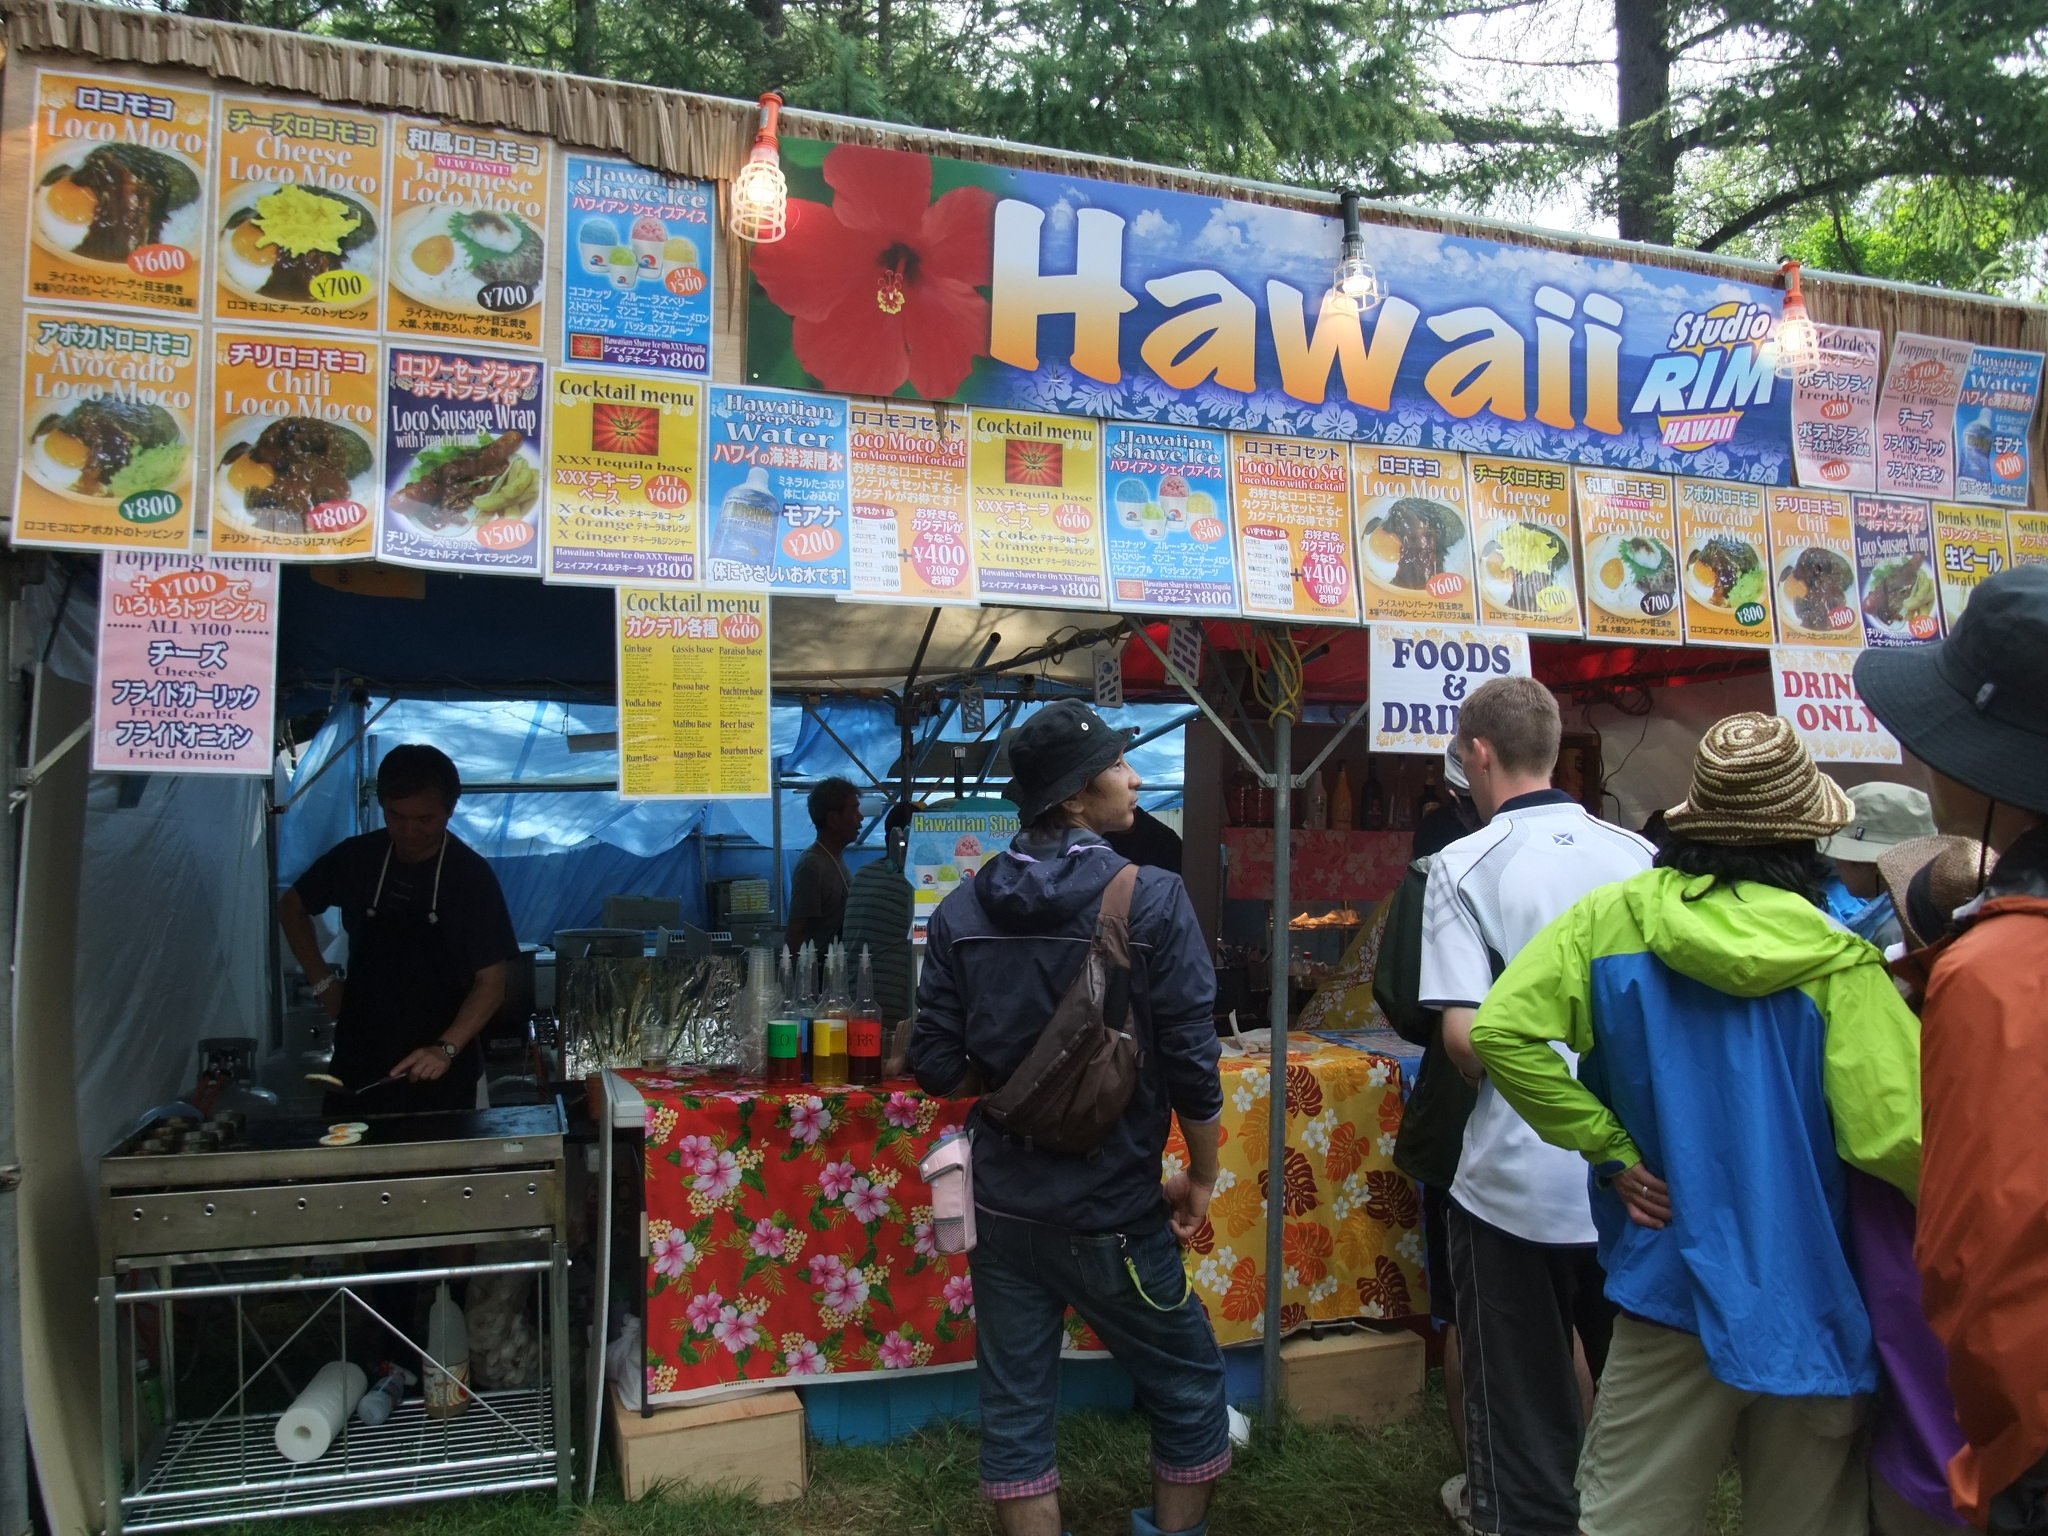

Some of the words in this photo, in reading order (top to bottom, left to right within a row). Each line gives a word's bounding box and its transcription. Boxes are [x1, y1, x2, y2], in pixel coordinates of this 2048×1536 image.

[76, 87, 174, 121] ロコモコ
[48, 109, 116, 139] Loco
[119, 124, 202, 154] Moco
[229, 109, 376, 146] チーズロコモコ
[256, 135, 353, 168] Cheese
[407, 127, 540, 166] 和風ロコモコ
[229, 156, 295, 184] Loco
[302, 168, 377, 194] Moco
[411, 161, 533, 196] Japanese
[402, 180, 463, 207] Loco
[472, 189, 541, 217] Moco
[577, 179, 660, 202] Shave
[668, 188, 706, 208] Ice
[133, 249, 186, 272] ¥600
[671, 277, 702, 292] ¥500
[674, 269, 695, 278] ALL
[317, 275, 362, 298] ¥700
[482, 284, 528, 308] ¥700
[569, 287, 612, 298] ココナッツ
[227, 301, 369, 321] ロコモコにチーズのトッピング
[989, 198, 1625, 437] Hawaii
[1667, 303, 1771, 349] Studio
[39, 321, 191, 357] アボカドロコモコ
[51, 351, 176, 383] Avocado
[229, 343, 367, 373] チリロコモコ
[661, 352, 705, 370] ¥800
[397, 354, 537, 388] ロコソーセージラップ
[1631, 342, 1776, 413] RIM
[1798, 370, 1874, 394] ポテトフライ
[35, 373, 109, 401] Loco
[112, 380, 191, 410] Moco
[266, 370, 332, 397] Chili
[413, 380, 519, 405] ポテトフライ付
[559, 379, 636, 403] Cocktail
[641, 388, 695, 407] menu
[225, 391, 290, 417] Loco
[300, 397, 372, 424] Moco
[726, 394, 834, 421] Hawaiian
[1824, 402, 1849, 416] ¥200
[1898, 408, 1934, 429] チーズ
[392, 405, 429, 432] Loco
[432, 404, 493, 437] Sausage
[495, 403, 536, 436] Wrap
[977, 416, 1043, 438] Cocktail
[1046, 425, 1093, 441] menu
[1662, 418, 1738, 445] HAWAII
[726, 422, 834, 449] Water
[1120, 430, 1213, 450] Hawaiian
[1799, 422, 1869, 443] ポテトフライ
[1113, 444, 1182, 462] Shave
[1188, 449, 1221, 465] Ice
[1245, 441, 1340, 461] ロコモコセット
[1883, 433, 1946, 457] フライドガーリック
[1994, 436, 2022, 453] モアナ
[557, 455, 592, 465] XXX
[593, 458, 652, 472] Tequila
[656, 462, 692, 473] base
[713, 444, 844, 472] ハワイの海洋深層水
[1238, 457, 1275, 476] Loco
[1277, 460, 1318, 479] Moco
[1320, 465, 1345, 481] Set
[1379, 455, 1440, 478] ロコモコ
[556, 470, 642, 490] XXXテキーラ
[656, 476, 682, 487] ALL
[1474, 465, 1564, 490] チーズロコモコ
[1822, 464, 1847, 477] ¥400
[1888, 461, 1944, 483] フライドオニオン
[778, 476, 844, 490] ミネラルたっぷり
[1362, 474, 1406, 498] Loco
[1410, 479, 1461, 502] Moco
[1585, 476, 1665, 500] 和風ロコモコ
[578, 488, 620, 504] ベース
[648, 486, 688, 504] ¥600
[783, 489, 840, 502] 体にしみ込む!
[1249, 488, 1335, 505] お好きなロコモコと
[1492, 485, 1551, 508] Cheese
[1684, 485, 1759, 508] アボカドロコモコ
[1776, 496, 1843, 517] チリロコモコ
[123, 494, 177, 520] ¥800
[312, 505, 361, 530] ¥800
[783, 504, 842, 528] モアナ
[1061, 505, 1085, 513] ALL
[1242, 499, 1343, 517] カクテルをセットすると
[1478, 502, 1517, 522] Loco
[1521, 508, 1566, 528] Moco
[1691, 504, 1753, 528] Avocado
[1858, 502, 1924, 521] ロコソーセージラップ
[24, 520, 185, 540] ロコモコにアボカドのトッピング
[1056, 514, 1090, 529] ¥600
[1589, 516, 1625, 535] Loco
[1629, 520, 1670, 540] Moco
[1797, 514, 1829, 533] Chili
[1938, 511, 1971, 526] Drinks
[1975, 514, 2001, 528] Menu
[483, 523, 527, 546] ¥500
[789, 530, 834, 557] ¥200
[1778, 530, 1810, 548] Loco
[1814, 534, 1850, 550] Moco
[1939, 527, 2002, 543] ドリンクメニュー
[114, 550, 204, 573] Topping
[210, 558, 273, 572] Menu
[913, 544, 965, 566] ¥400
[1944, 544, 2002, 573] 生ビール
[648, 562, 693, 578] ¥800
[713, 562, 846, 586] 体にやさしいお水です!
[1303, 564, 1347, 584] ¥400
[1947, 574, 1977, 587] Draft
[1060, 583, 1099, 597] ¥800
[1193, 591, 1231, 604] ¥800
[1429, 576, 1462, 596] ¥600
[113, 594, 266, 623] いろいろトッピング!
[627, 592, 701, 612] Cocktail
[708, 599, 760, 613] menu
[1644, 594, 1670, 613] ¥700
[1737, 605, 1764, 623] ¥800
[147, 620, 182, 634] ALL
[190, 623, 232, 636] ¥100
[624, 616, 720, 639] カクテル各種
[730, 615, 753, 623] ALL
[1829, 610, 1853, 627] ¥800
[724, 623, 759, 638] ¥600
[149, 640, 229, 669] チーズ
[672, 645, 695, 653] Cassis
[1391, 638, 1511, 674] FOODS
[154, 667, 217, 678] Cheese
[112, 680, 260, 710] フライドガーリック
[1442, 674, 1467, 700] &
[1782, 671, 1863, 699] DRIN
[131, 707, 178, 718] Fried
[184, 708, 237, 720] Garlic
[625, 699, 645, 707] Vodka
[720, 720, 737, 728] Beer
[738, 720, 754, 728] base
[1381, 702, 1460, 735] DRI
[1797, 704, 1880, 733] ONLY
[116, 720, 253, 750] フライドオニオン
[129, 749, 175, 759] Fried
[181, 750, 235, 761] Onion
[914, 816, 986, 832] Hawaiian
